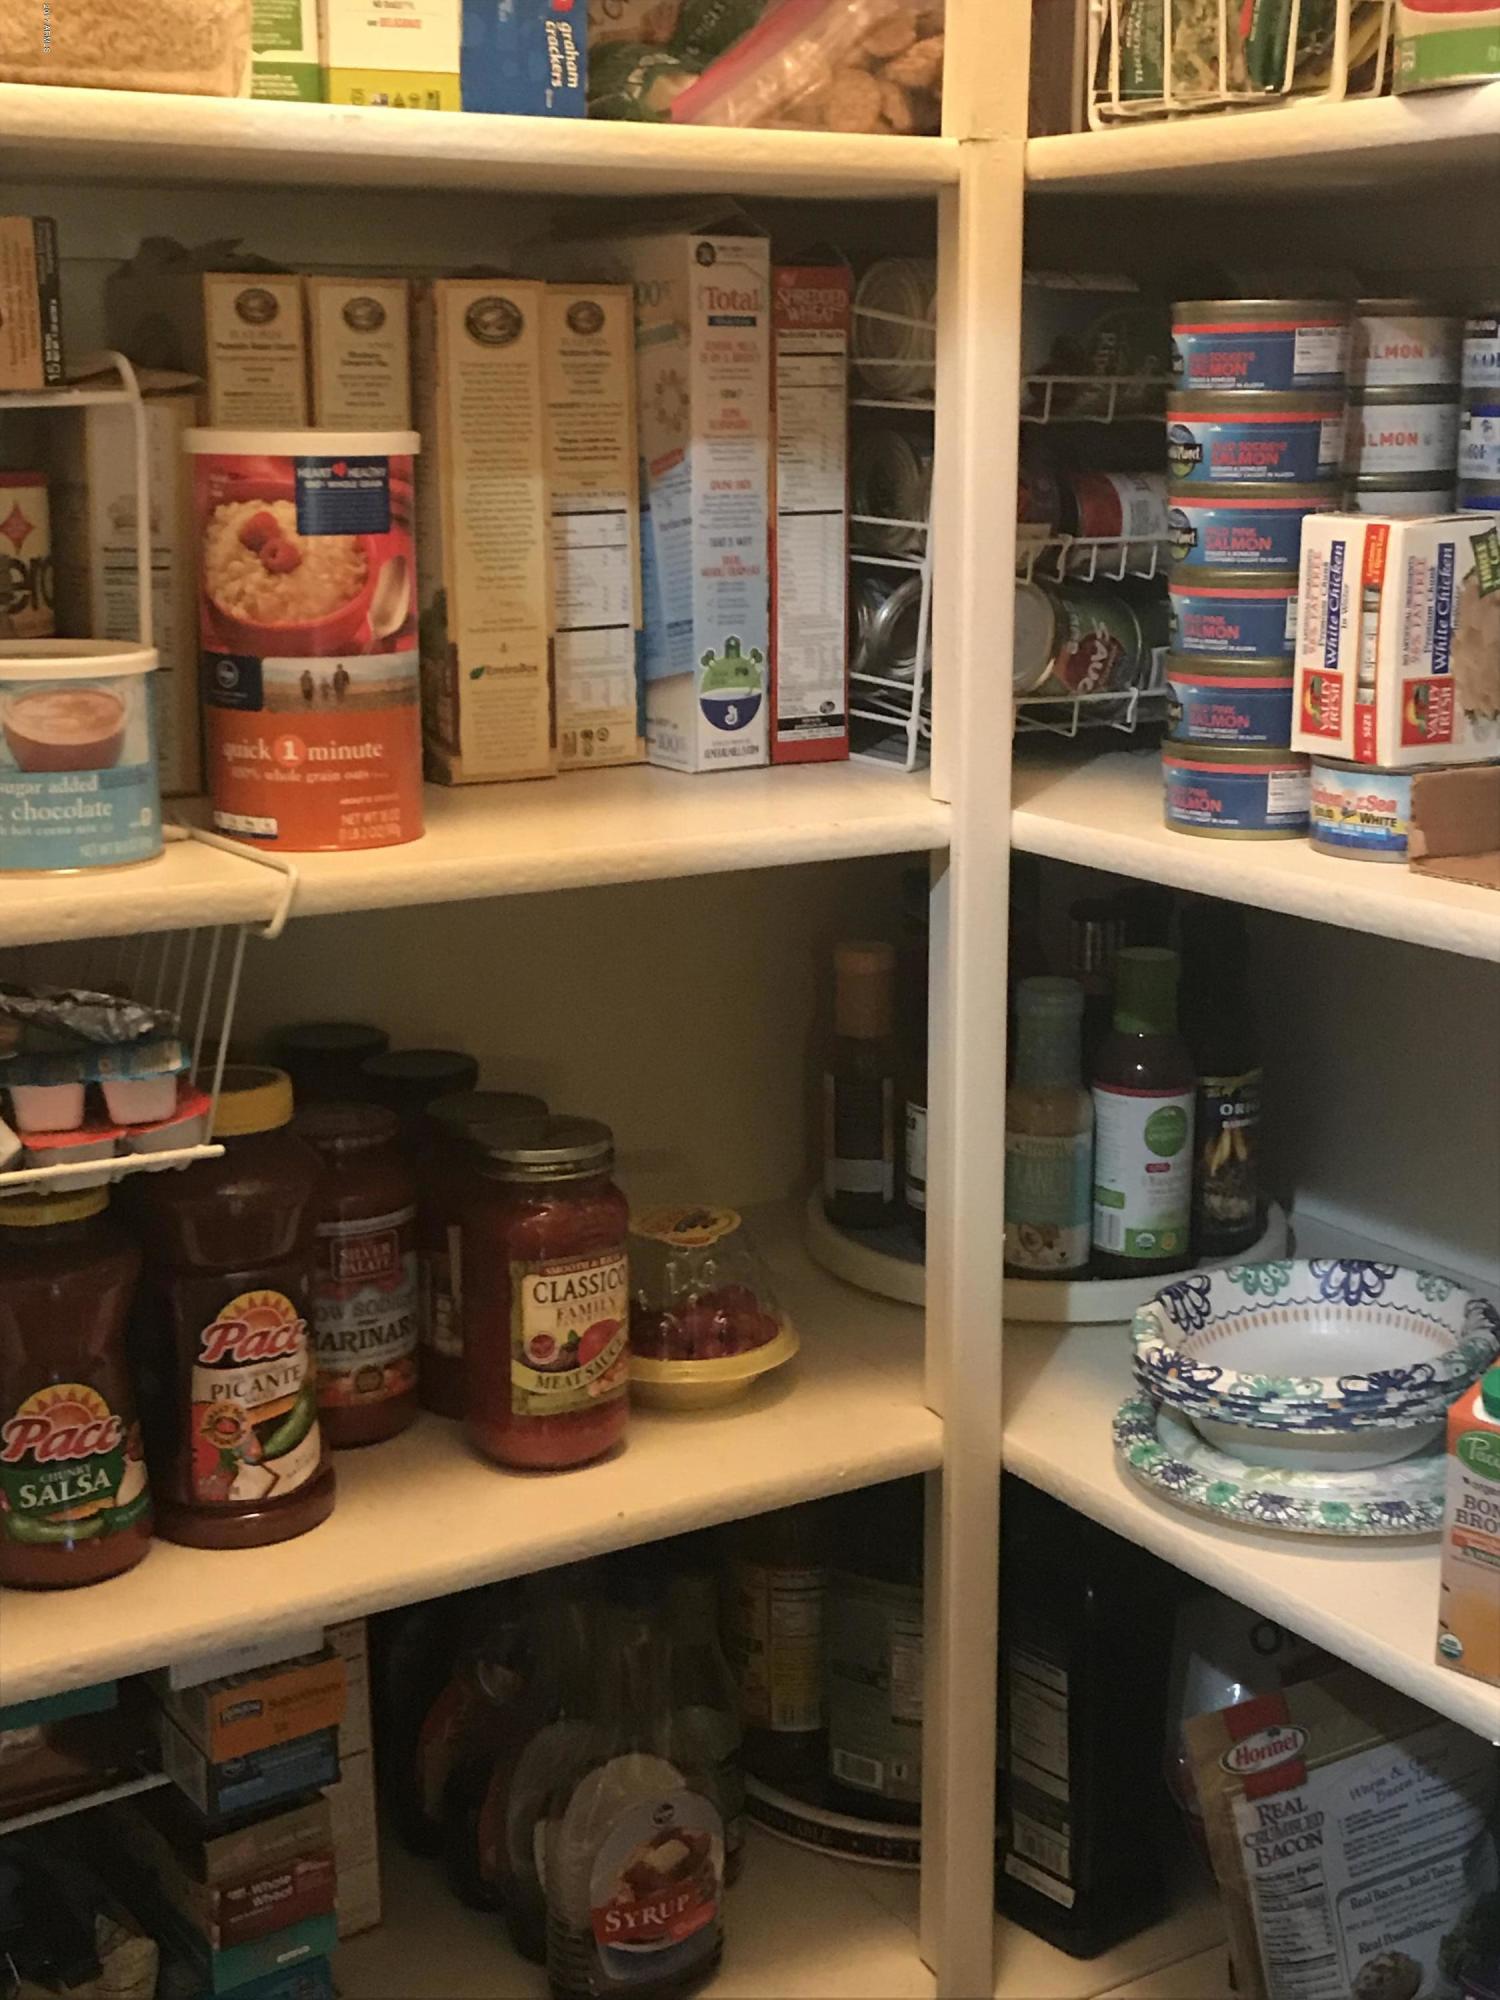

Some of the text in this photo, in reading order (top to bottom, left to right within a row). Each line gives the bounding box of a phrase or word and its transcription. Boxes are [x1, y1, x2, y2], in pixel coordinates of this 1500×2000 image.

[545, 20, 565, 88] crackers
[557, 22, 580, 88] graham
[704, 285, 760, 312] Total
[1211, 450, 1280, 465] SALMON
[1205, 537, 1273, 551] SALMON
[1413, 557, 1426, 598] FREE
[1325, 544, 1344, 666] White Chicken
[1434, 546, 1453, 671] White Chicken
[1184, 624, 1240, 639] SALMON
[1077, 617, 1110, 692] SAUC
[1188, 712, 1250, 728] SALMON
[1319, 677, 1331, 731] VALLEY
[1328, 682, 1341, 731] FRESH
[1427, 685, 1438, 739] VALLEY
[1436, 686, 1451, 735] FRESH
[1362, 712, 1373, 738] SIZE
[224, 738, 384, 762] quick 1 minute
[48, 775, 98, 794] added
[264, 769, 301, 782] whole
[306, 771, 341, 784] grain
[344, 769, 369, 781] oats
[11, 797, 113, 821] chocolate
[1171, 798, 1223, 813] SALMON
[1359, 812, 1398, 828] WHITE
[533, 1264, 625, 1304] CLASSICO
[556, 1295, 618, 1322] FAMILY
[584, 1337, 623, 1377] SAUCE
[211, 1364, 300, 1400] PICANTE
[535, 1372, 582, 1389] MEAT
[0, 1414, 123, 1463] Pace
[19, 1468, 112, 1509] SALSA
[39, 1463, 92, 1483] CHUNKY
[1235, 1729, 1300, 1767] Hormel
[1244, 1810, 1325, 1848] CRUMBLED
[1256, 1796, 1309, 1826] REAL
[1253, 1829, 1324, 1868] BACON
[1350, 1893, 1373, 1910] Real
[1408, 1870, 1431, 1888] Real
[604, 1893, 690, 1934] SYRUP
[1358, 1936, 1383, 1955] Real
